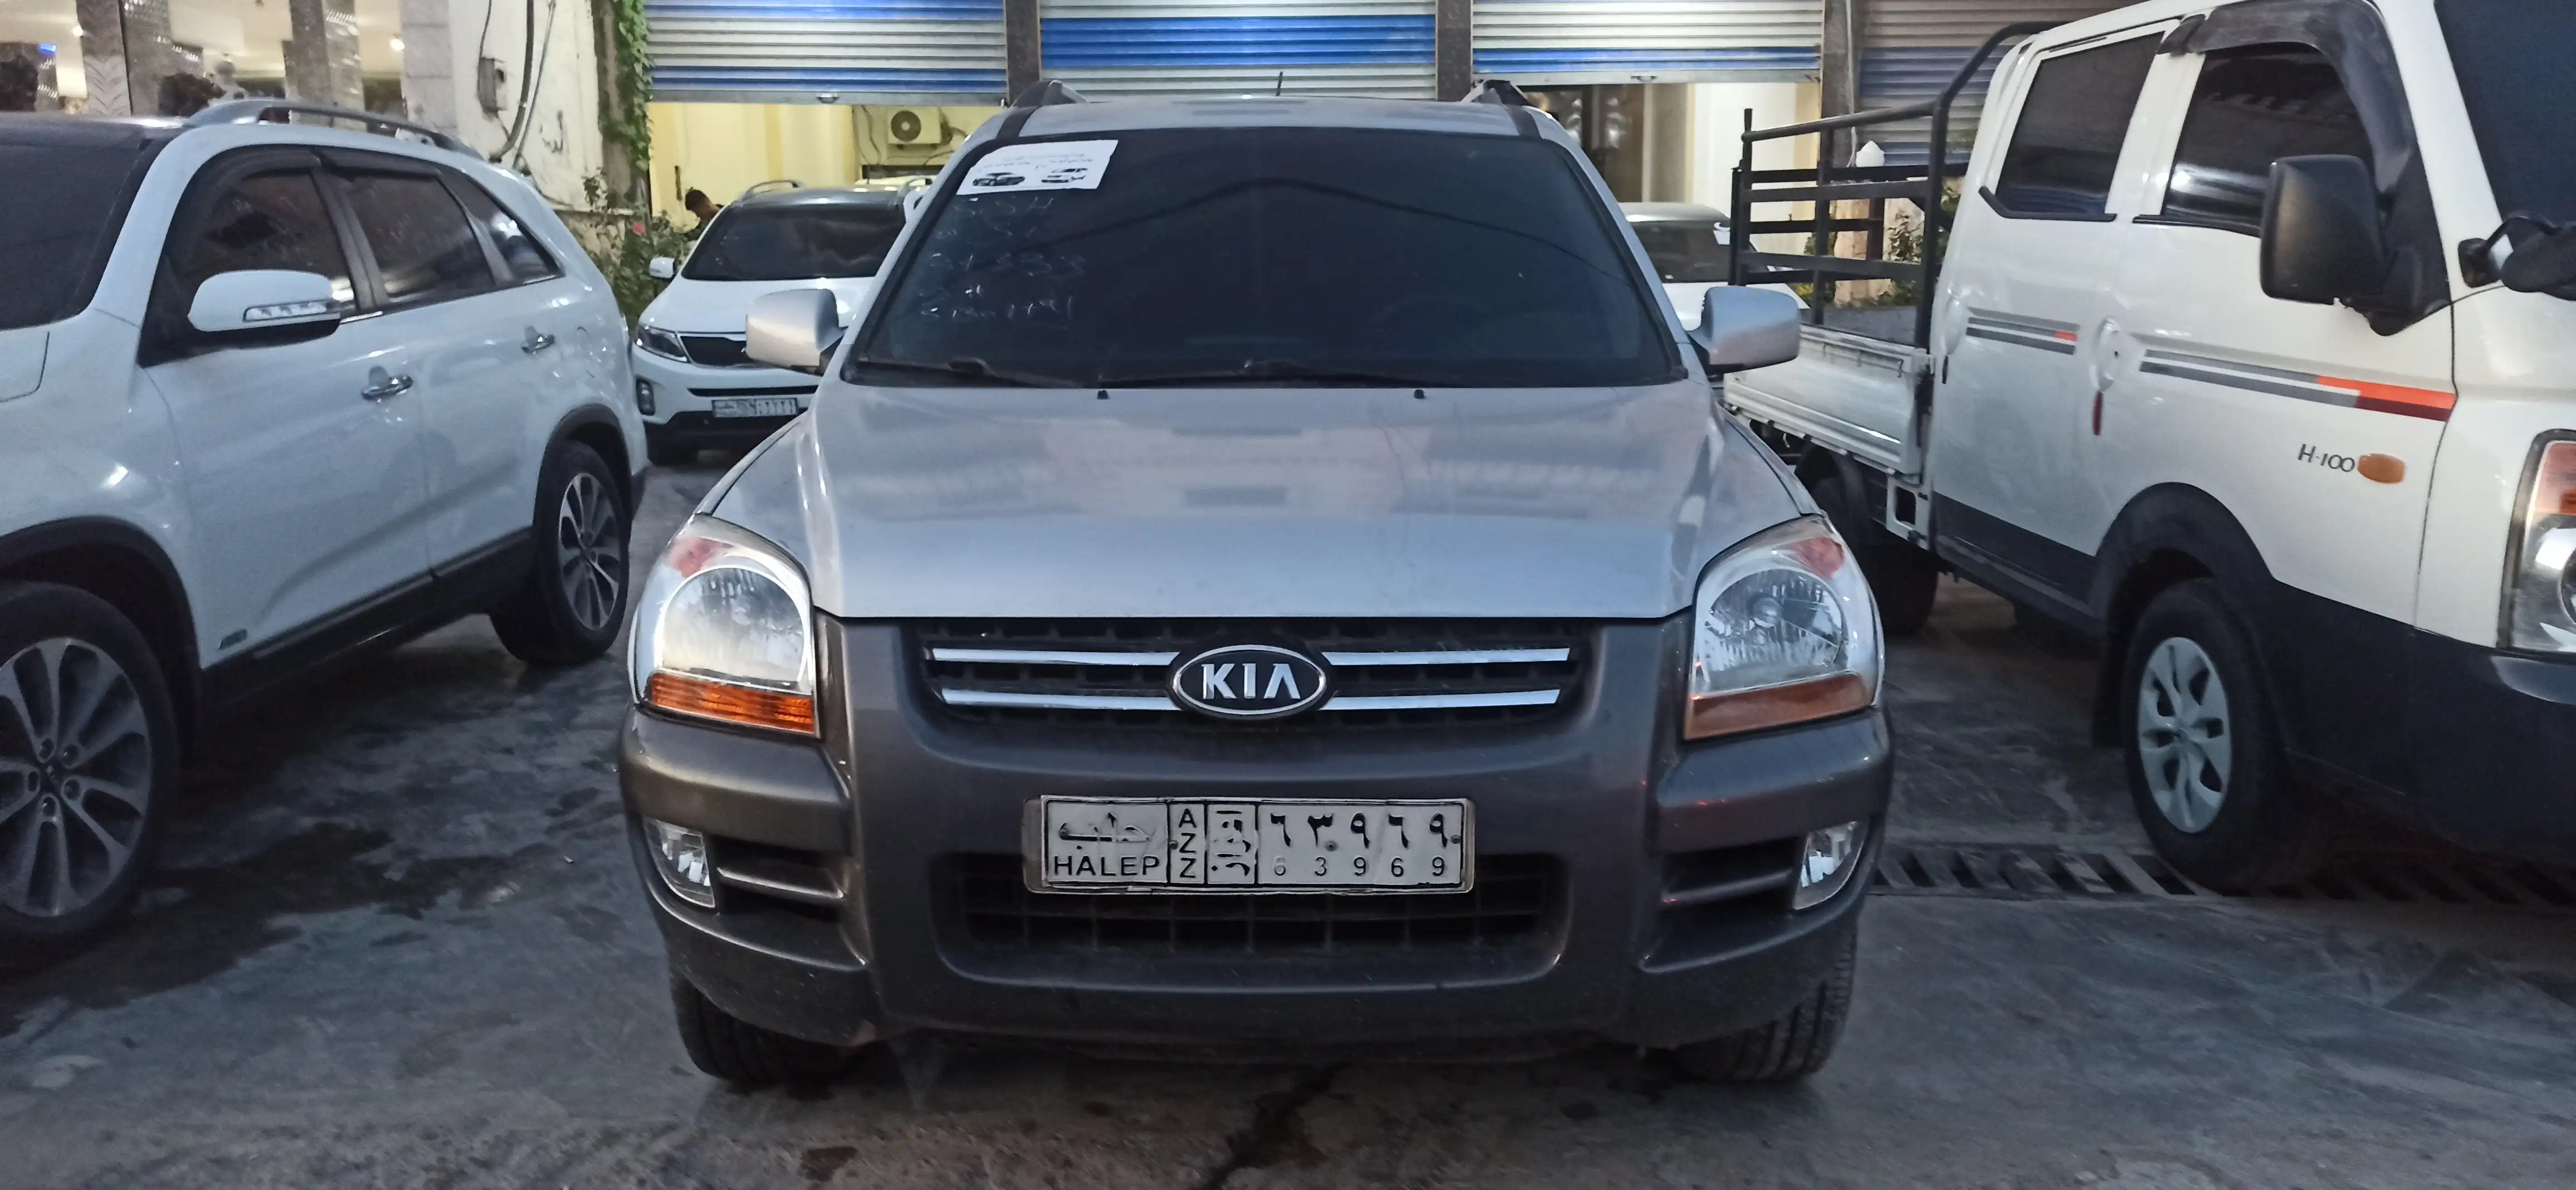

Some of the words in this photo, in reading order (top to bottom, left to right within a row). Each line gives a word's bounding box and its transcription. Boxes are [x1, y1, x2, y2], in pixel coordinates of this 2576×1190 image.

[2297, 443, 2355, 472] H-100
[1201, 663, 1301, 700] KIA
[1059, 812, 1152, 850] حلب
[1053, 855, 1160, 876] HALEP
[1274, 856, 1446, 877] 63969
